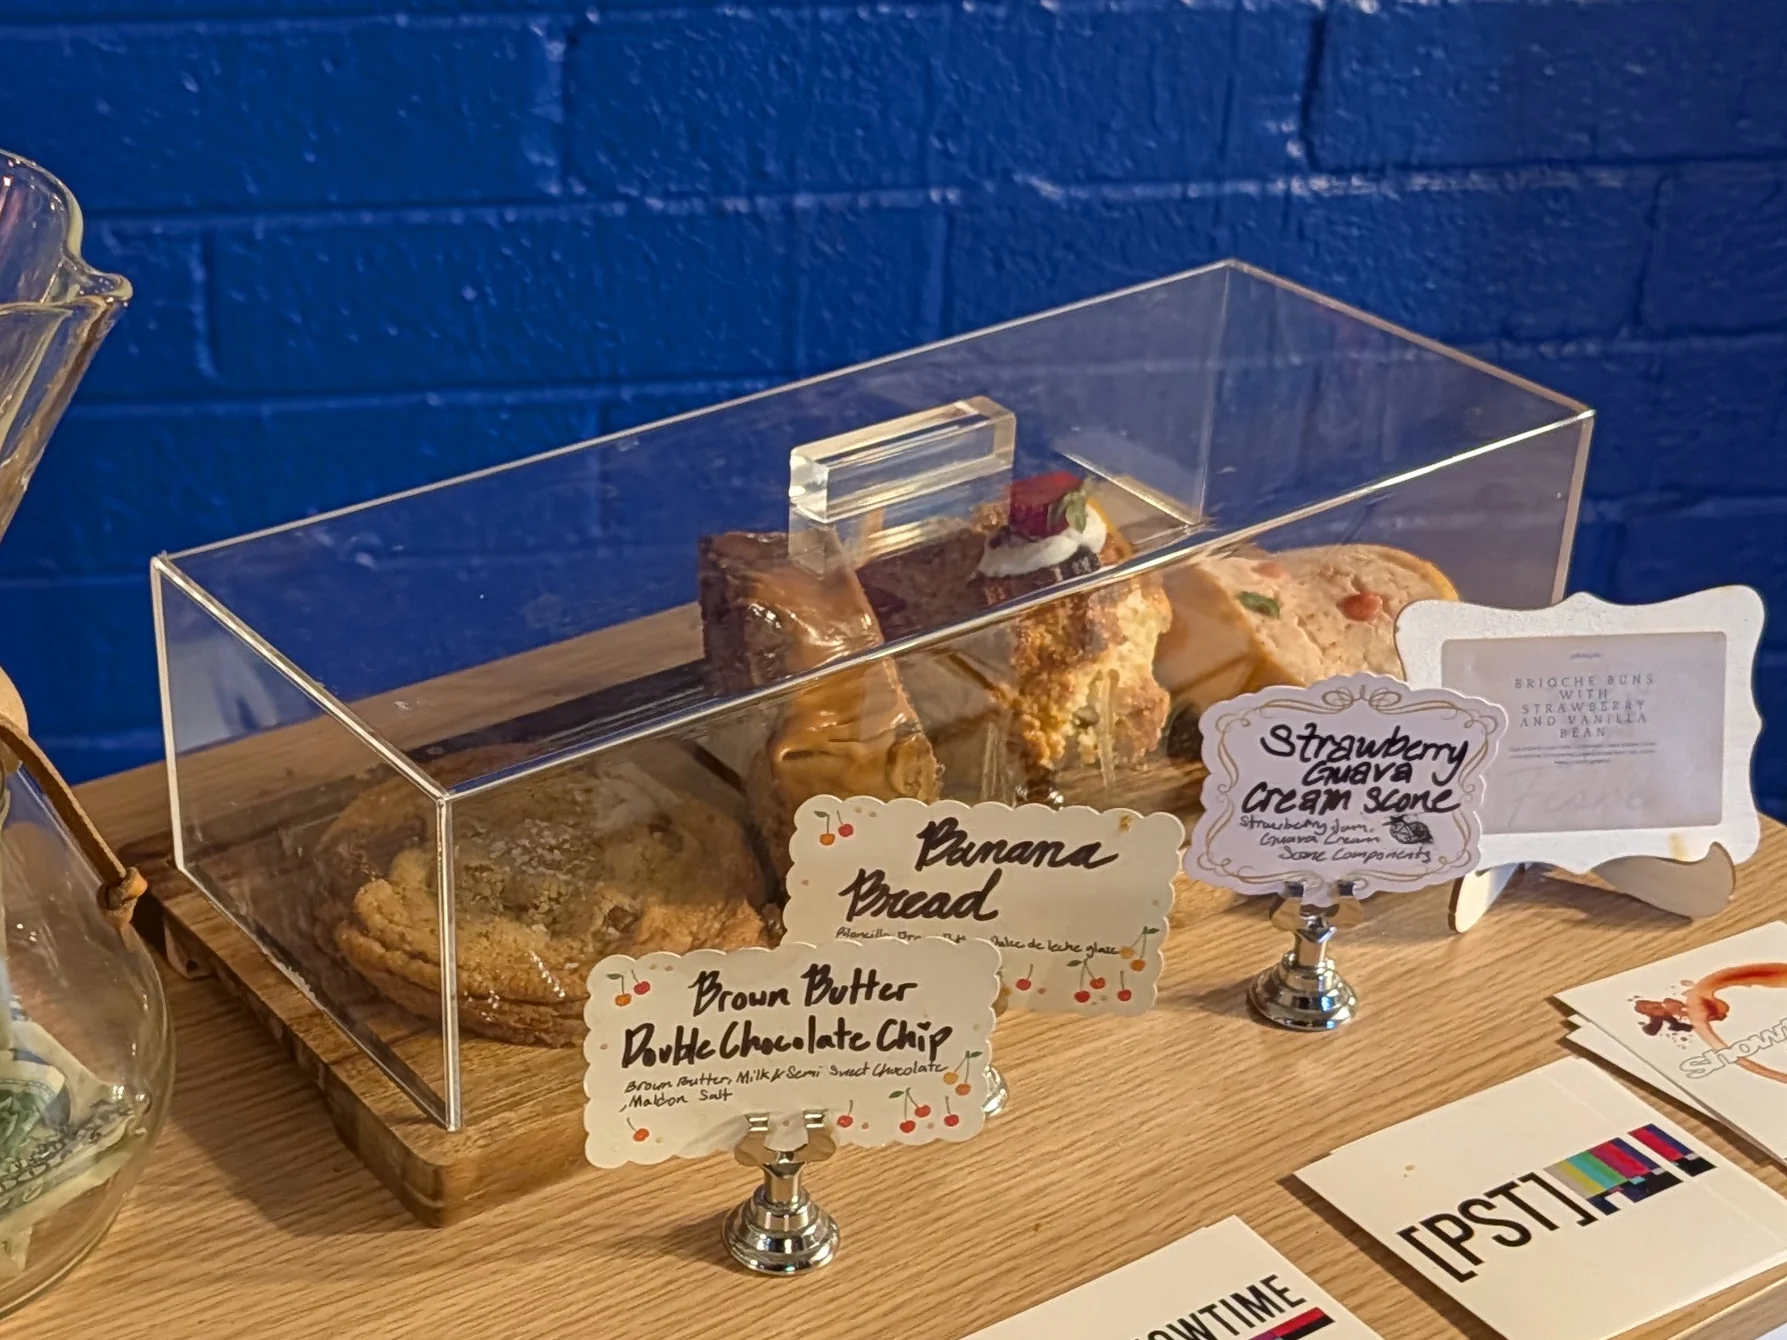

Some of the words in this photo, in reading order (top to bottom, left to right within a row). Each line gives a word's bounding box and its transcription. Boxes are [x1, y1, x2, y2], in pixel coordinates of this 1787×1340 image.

[1514, 676, 1596, 689] BRIOCHE
[1607, 673, 1655, 686] BUNS
[1559, 688, 1608, 700] WITH
[1521, 700, 1645, 715] STRAWBERRY
[1520, 716, 1556, 728] AND
[1568, 712, 1647, 726] VANILLA
[1560, 727, 1606, 739] BEAN
[1260, 723, 1468, 786] Strawberry
[1302, 760, 1413, 786] Guava
[1241, 782, 1351, 815] Cream
[1239, 815, 1327, 836] Strawberry
[915, 817, 1118, 872] Banana
[1259, 833, 1318, 847] Guava
[1323, 832, 1381, 845] Cream
[1331, 846, 1431, 864] Components
[839, 868, 1002, 921] Bread
[1028, 938, 1045, 950] de
[688, 970, 791, 1017] Brown
[801, 963, 918, 1006] Butter
[621, 1022, 716, 1068] Double
[719, 1015, 870, 1058] Chocolate
[876, 1018, 953, 1063] Chip
[1680, 1017, 1787, 1079] Show
[625, 1080, 672, 1093] Brown
[736, 1068, 769, 1084] Milk
[786, 1065, 820, 1079] Semi
[871, 1060, 948, 1078] Chocolate
[699, 1088, 733, 1101] Salt
